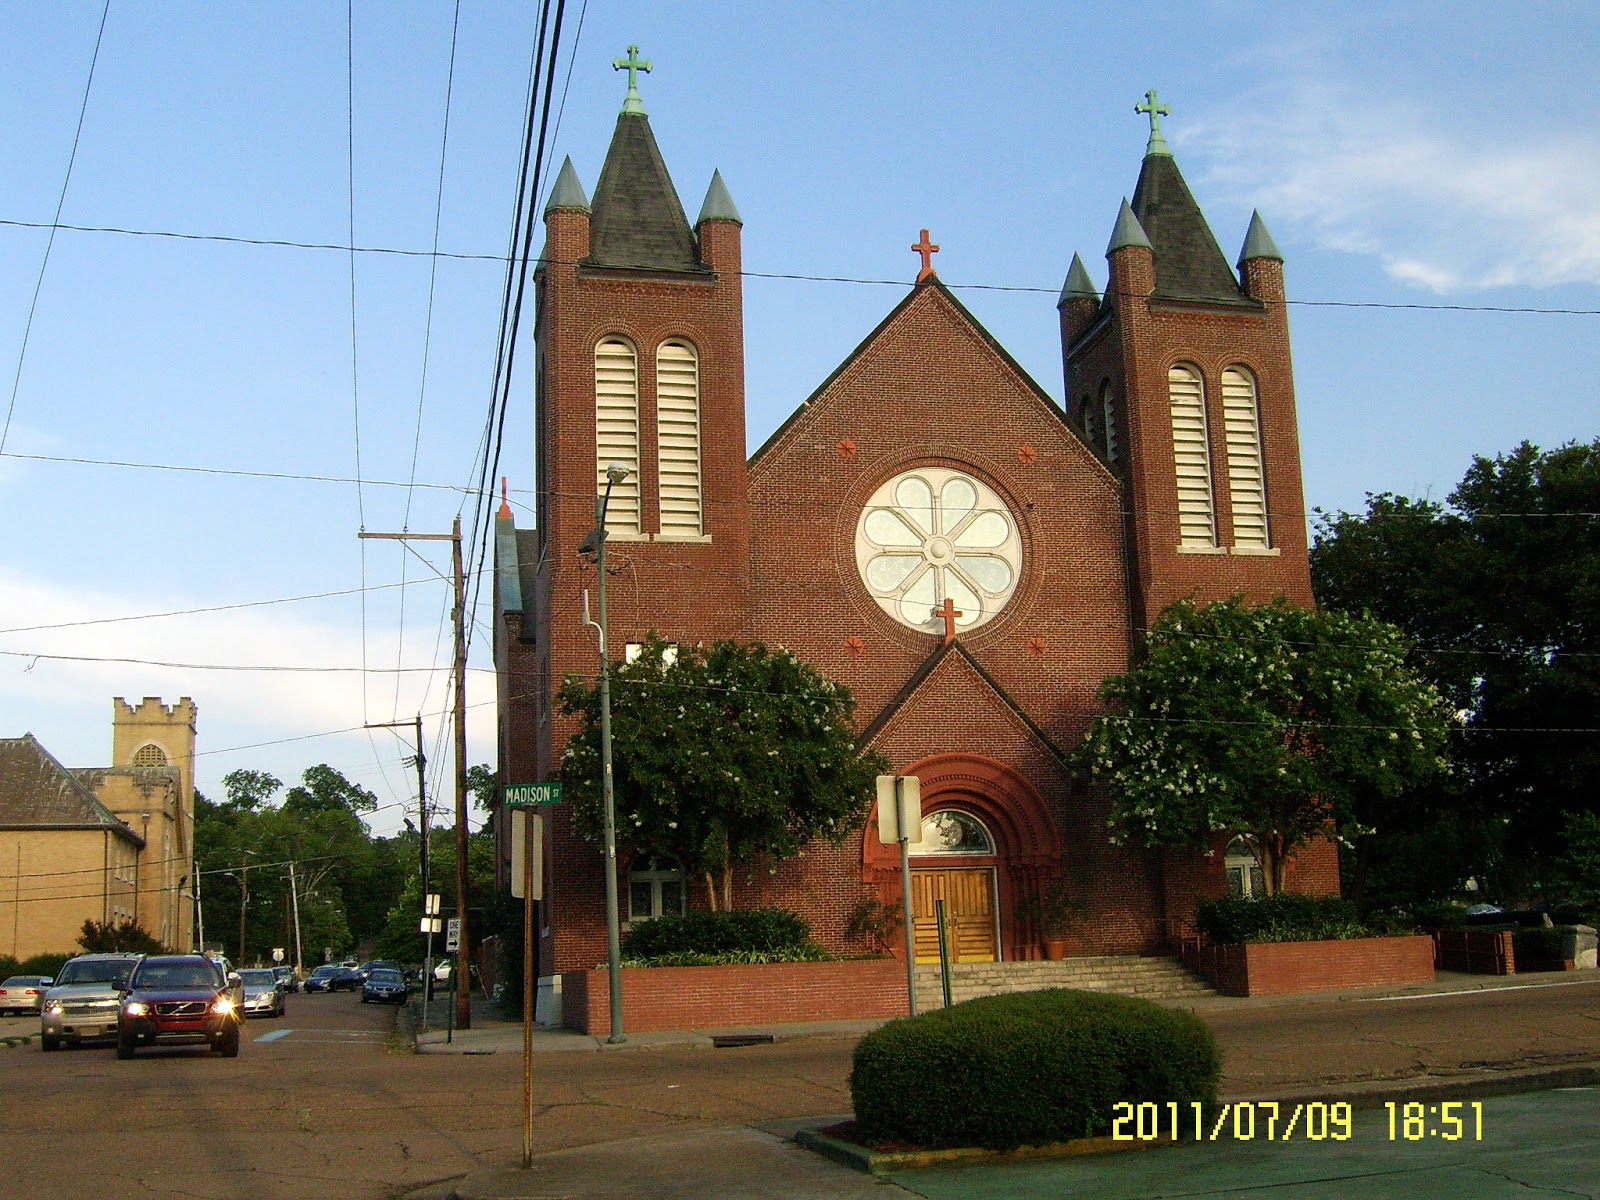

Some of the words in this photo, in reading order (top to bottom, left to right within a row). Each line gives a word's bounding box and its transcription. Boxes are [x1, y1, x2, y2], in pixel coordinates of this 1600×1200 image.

[505, 786, 551, 804] MADISON
[552, 788, 560, 798] ST
[449, 920, 459, 930] ONE
[449, 930, 459, 939] WAY
